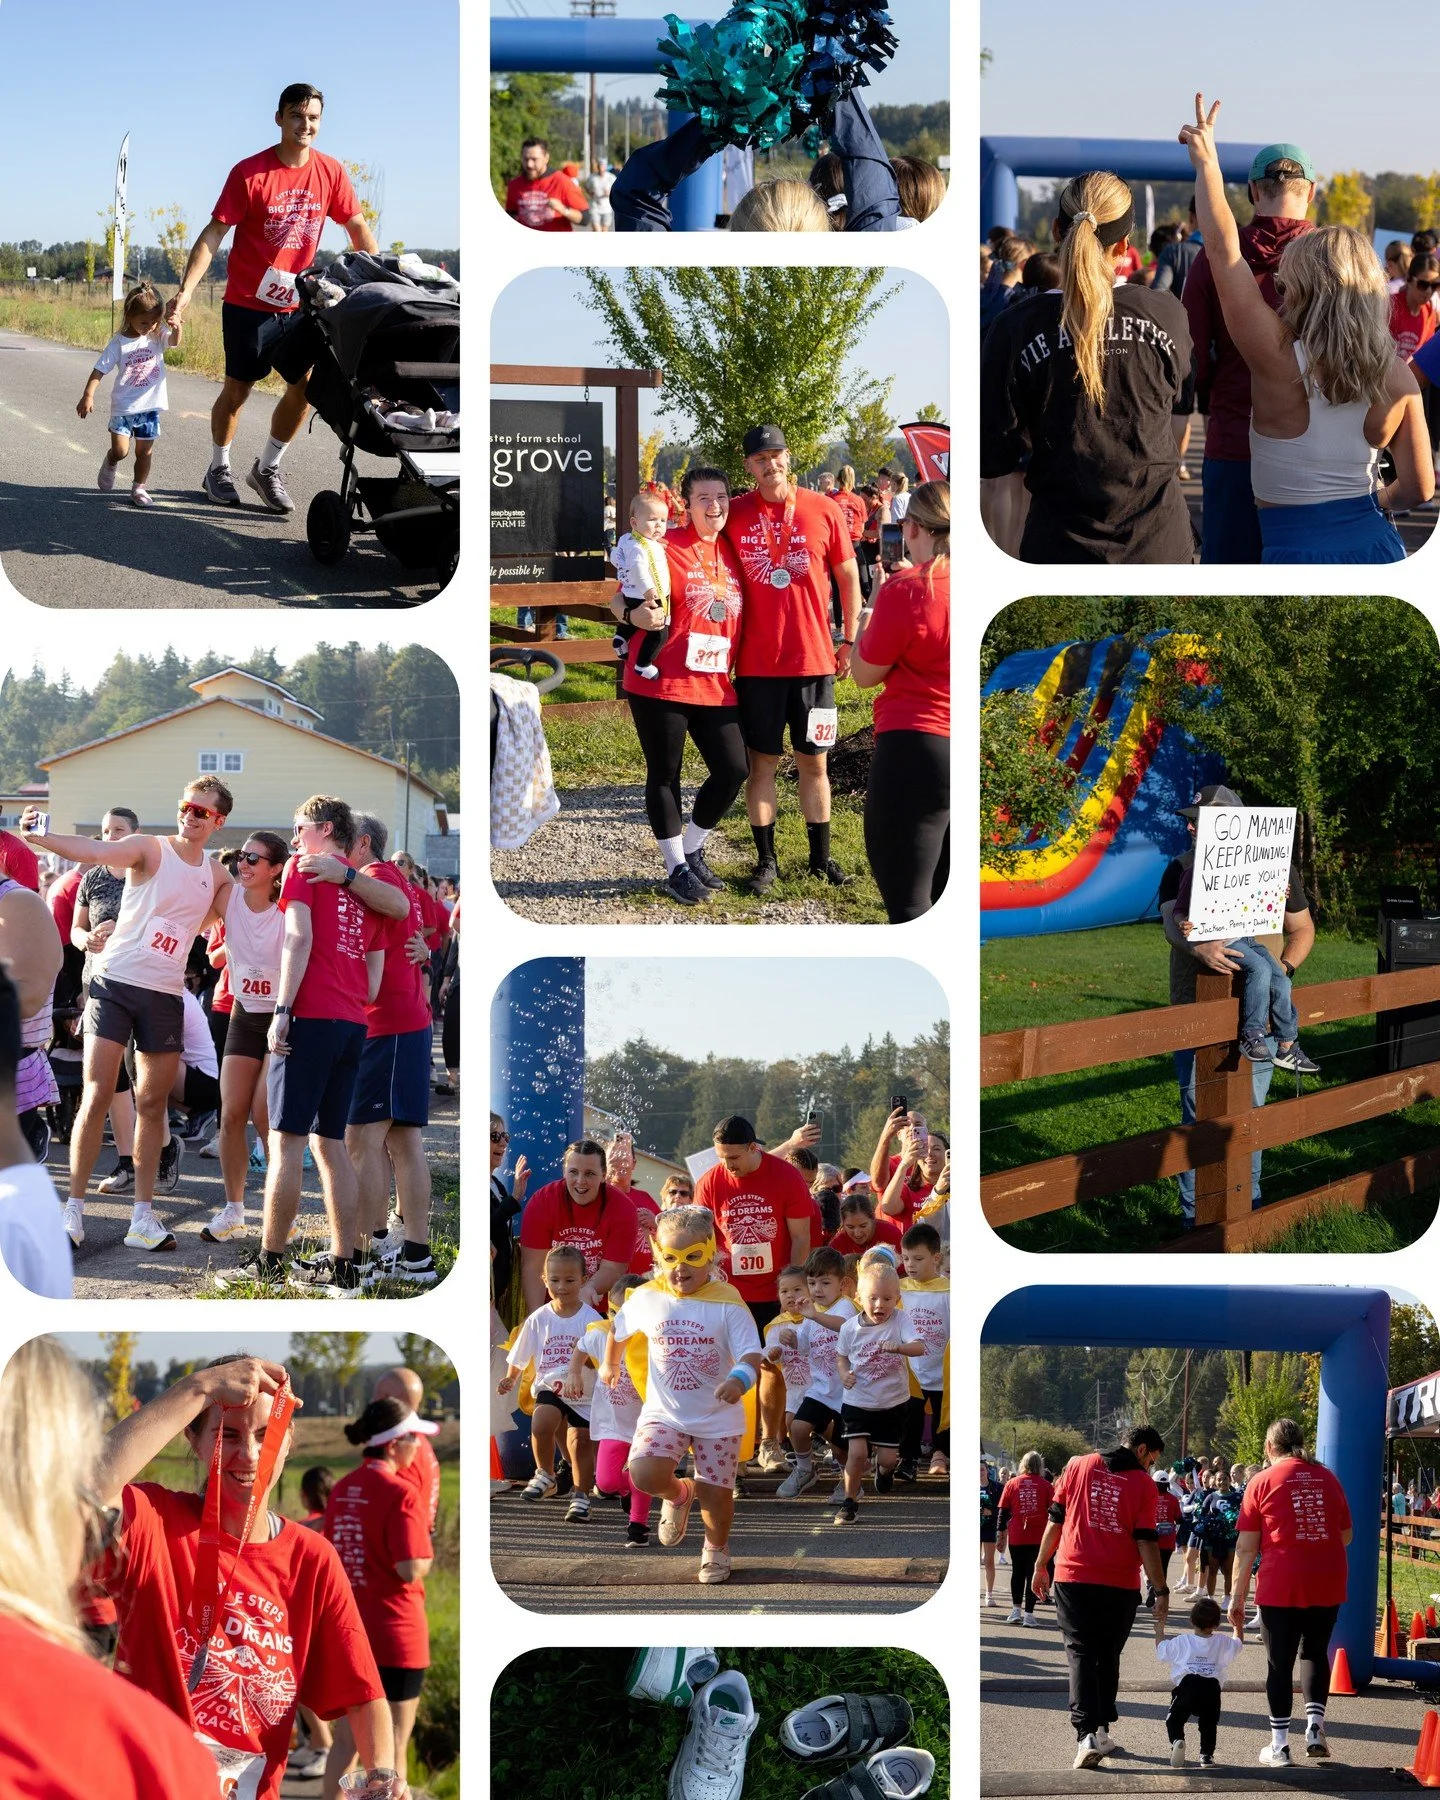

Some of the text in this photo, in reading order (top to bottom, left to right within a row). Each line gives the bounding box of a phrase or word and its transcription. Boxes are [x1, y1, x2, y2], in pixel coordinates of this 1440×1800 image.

[268, 203, 321, 214] BIG DREAMS
[266, 283, 295, 303] 224
[1021, 332, 1051, 373] VIE
[516, 433, 542, 443] farm
[546, 434, 581, 443] school
[492, 449, 593, 487] grove
[491, 520, 516, 528] FARM
[741, 535, 758, 544] BIG
[498, 565, 531, 579] possible
[533, 565, 545, 577] by:
[687, 571, 705, 579] BIG
[1215, 813, 1293, 841] GO MAMA!!
[1202, 868, 1280, 892] WE LOVE YOU!
[151, 931, 179, 955] 247
[242, 978, 271, 995] 246
[728, 1194, 766, 1206] LITTLE STEPS
[722, 1206, 773, 1217] BIG DREAMS
[741, 1256, 765, 1270] 370
[655, 1320, 705, 1332] LITTLE STEPS
[668, 1336, 715, 1346] DREAMS
[674, 1383, 701, 1391] RACE
[676, 1376, 694, 1384] 10K
[247, 1595, 285, 1623] STEPS
[210, 1636, 277, 1667] 20 25
[220, 1691, 239, 1704] 5K
[207, 1701, 240, 1722] 10K
[195, 1711, 242, 1736] RACE
